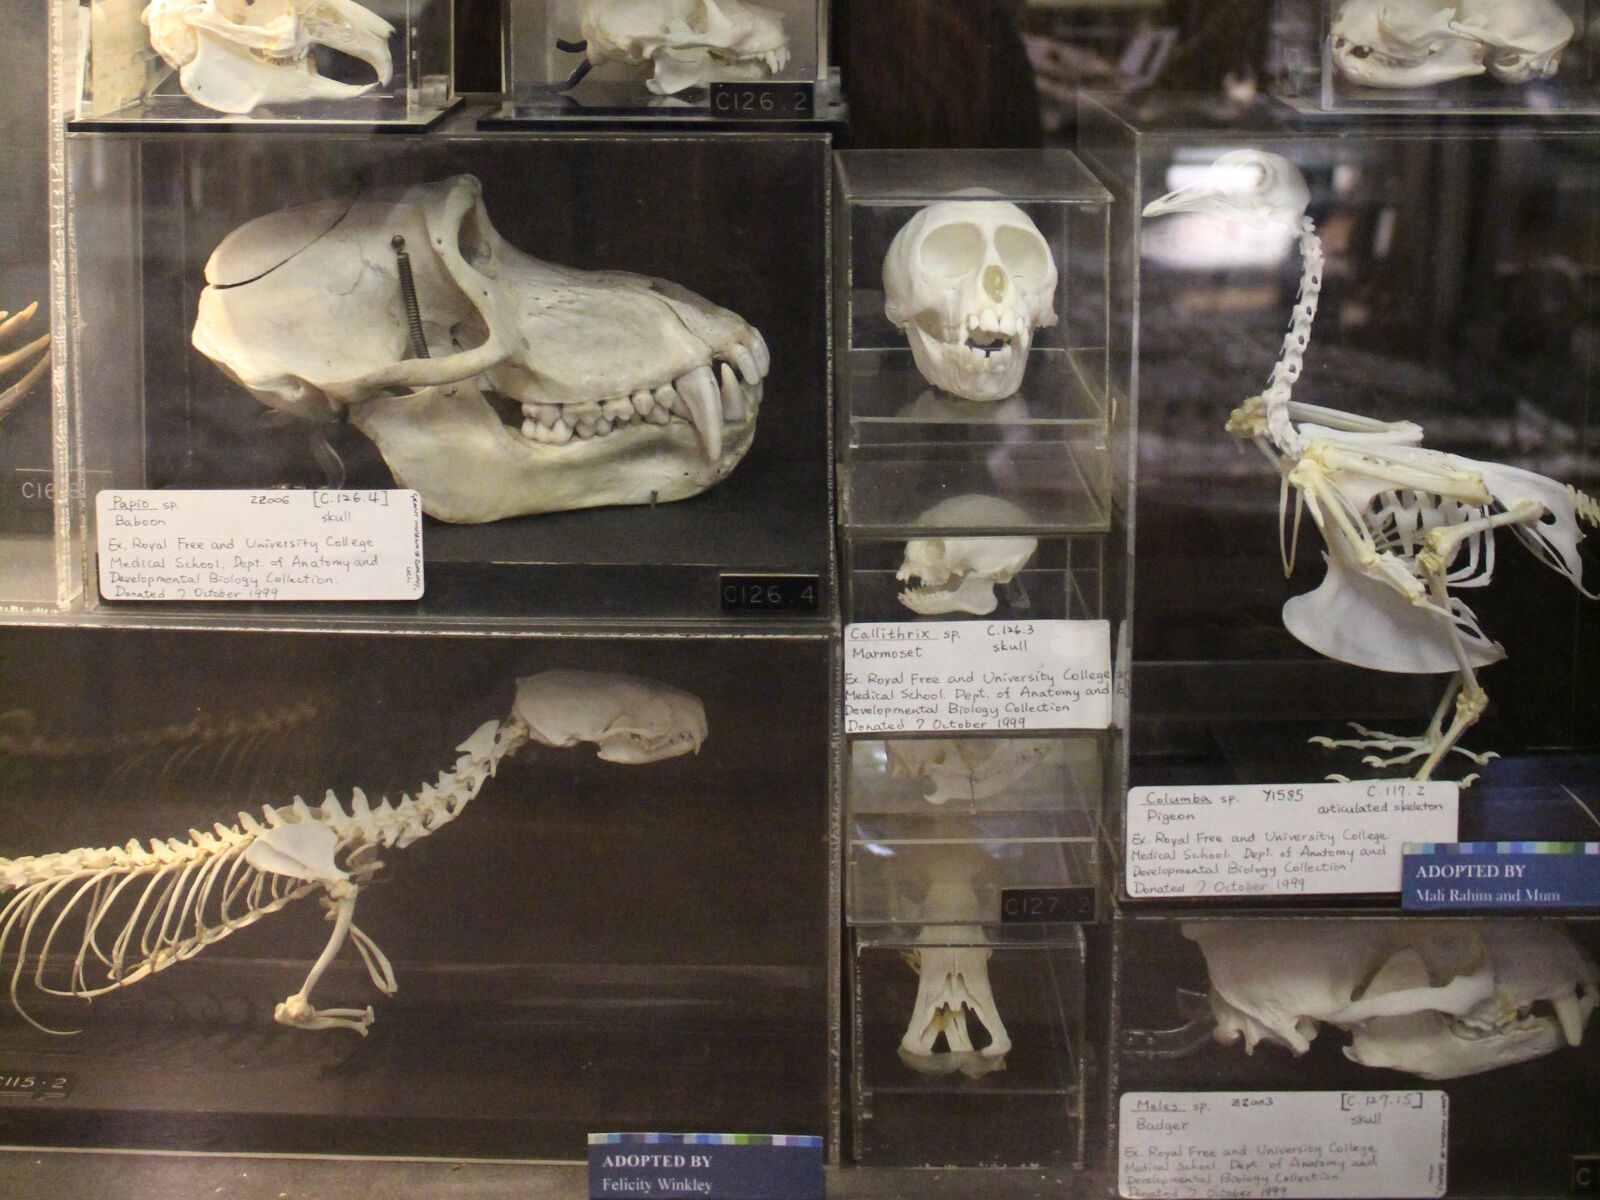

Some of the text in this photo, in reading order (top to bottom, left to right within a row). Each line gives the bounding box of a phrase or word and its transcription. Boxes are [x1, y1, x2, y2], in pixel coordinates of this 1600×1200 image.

[716, 92, 807, 110] C126.2
[113, 496, 150, 512] Papio
[162, 502, 179, 511] sp.
[116, 511, 351, 526] Baboon skull
[132, 537, 167, 549] Royal
[177, 537, 204, 549] Free
[211, 538, 234, 549] and
[246, 538, 318, 553] University
[325, 536, 374, 552] College
[110, 555, 378, 571] Medical School. Dept. of Anatomy and
[110, 571, 200, 586] Developmental
[210, 572, 258, 587] Biology
[116, 586, 278, 600] Donated October 1999
[724, 586, 814, 603] C126.4
[850, 625, 1034, 643] Callithrix sp. C.126.3
[853, 640, 1027, 659] Marmoset skull
[868, 672, 903, 686] Royal
[911, 673, 940, 685] Free
[948, 671, 974, 683] and
[983, 671, 1054, 689] University
[1063, 668, 1111, 687] College
[846, 690, 894, 700] Medical
[997, 687, 1010, 698] of
[1020, 686, 1080, 702] Anatomy
[1086, 683, 1109, 695] and
[845, 702, 1070, 718] Developmental Biology Collection
[848, 717, 1025, 731] Donated October 1999
[1146, 792, 1212, 804] Columba
[1220, 796, 1239, 806] sp.
[1147, 801, 1443, 824] Pigeon articulated skeleton
[1155, 832, 1190, 847] Royal
[1197, 833, 1223, 843] Free
[1232, 833, 1255, 842] and
[1265, 831, 1334, 846] University
[1343, 829, 1388, 844] College
[1132, 850, 1176, 861] Medical
[1280, 846, 1291, 858] of
[1300, 845, 1354, 861] Anatomy
[1360, 844, 1386, 855] and
[1133, 861, 1346, 877] Developmental Biology Collection
[1416, 865, 1527, 878] ADOPTED BY
[1135, 878, 1305, 894] Donated October 1999
[1416, 889, 1561, 902] Mali Rahim and Mum
[0, 1076, 67, 1088] 115.2
[1137, 1100, 1178, 1111] Meles
[1137, 1113, 1381, 1135] Badger skull
[1149, 1143, 1377, 1160] Royal Free and University College
[602, 1155, 713, 1168] ADOPTED BY
[1125, 1155, 1377, 1173] Medical Anatomy and
[603, 1178, 713, 1195] Felicity Winkley
[1127, 1172, 1338, 1186] Developmental Biology Collection
